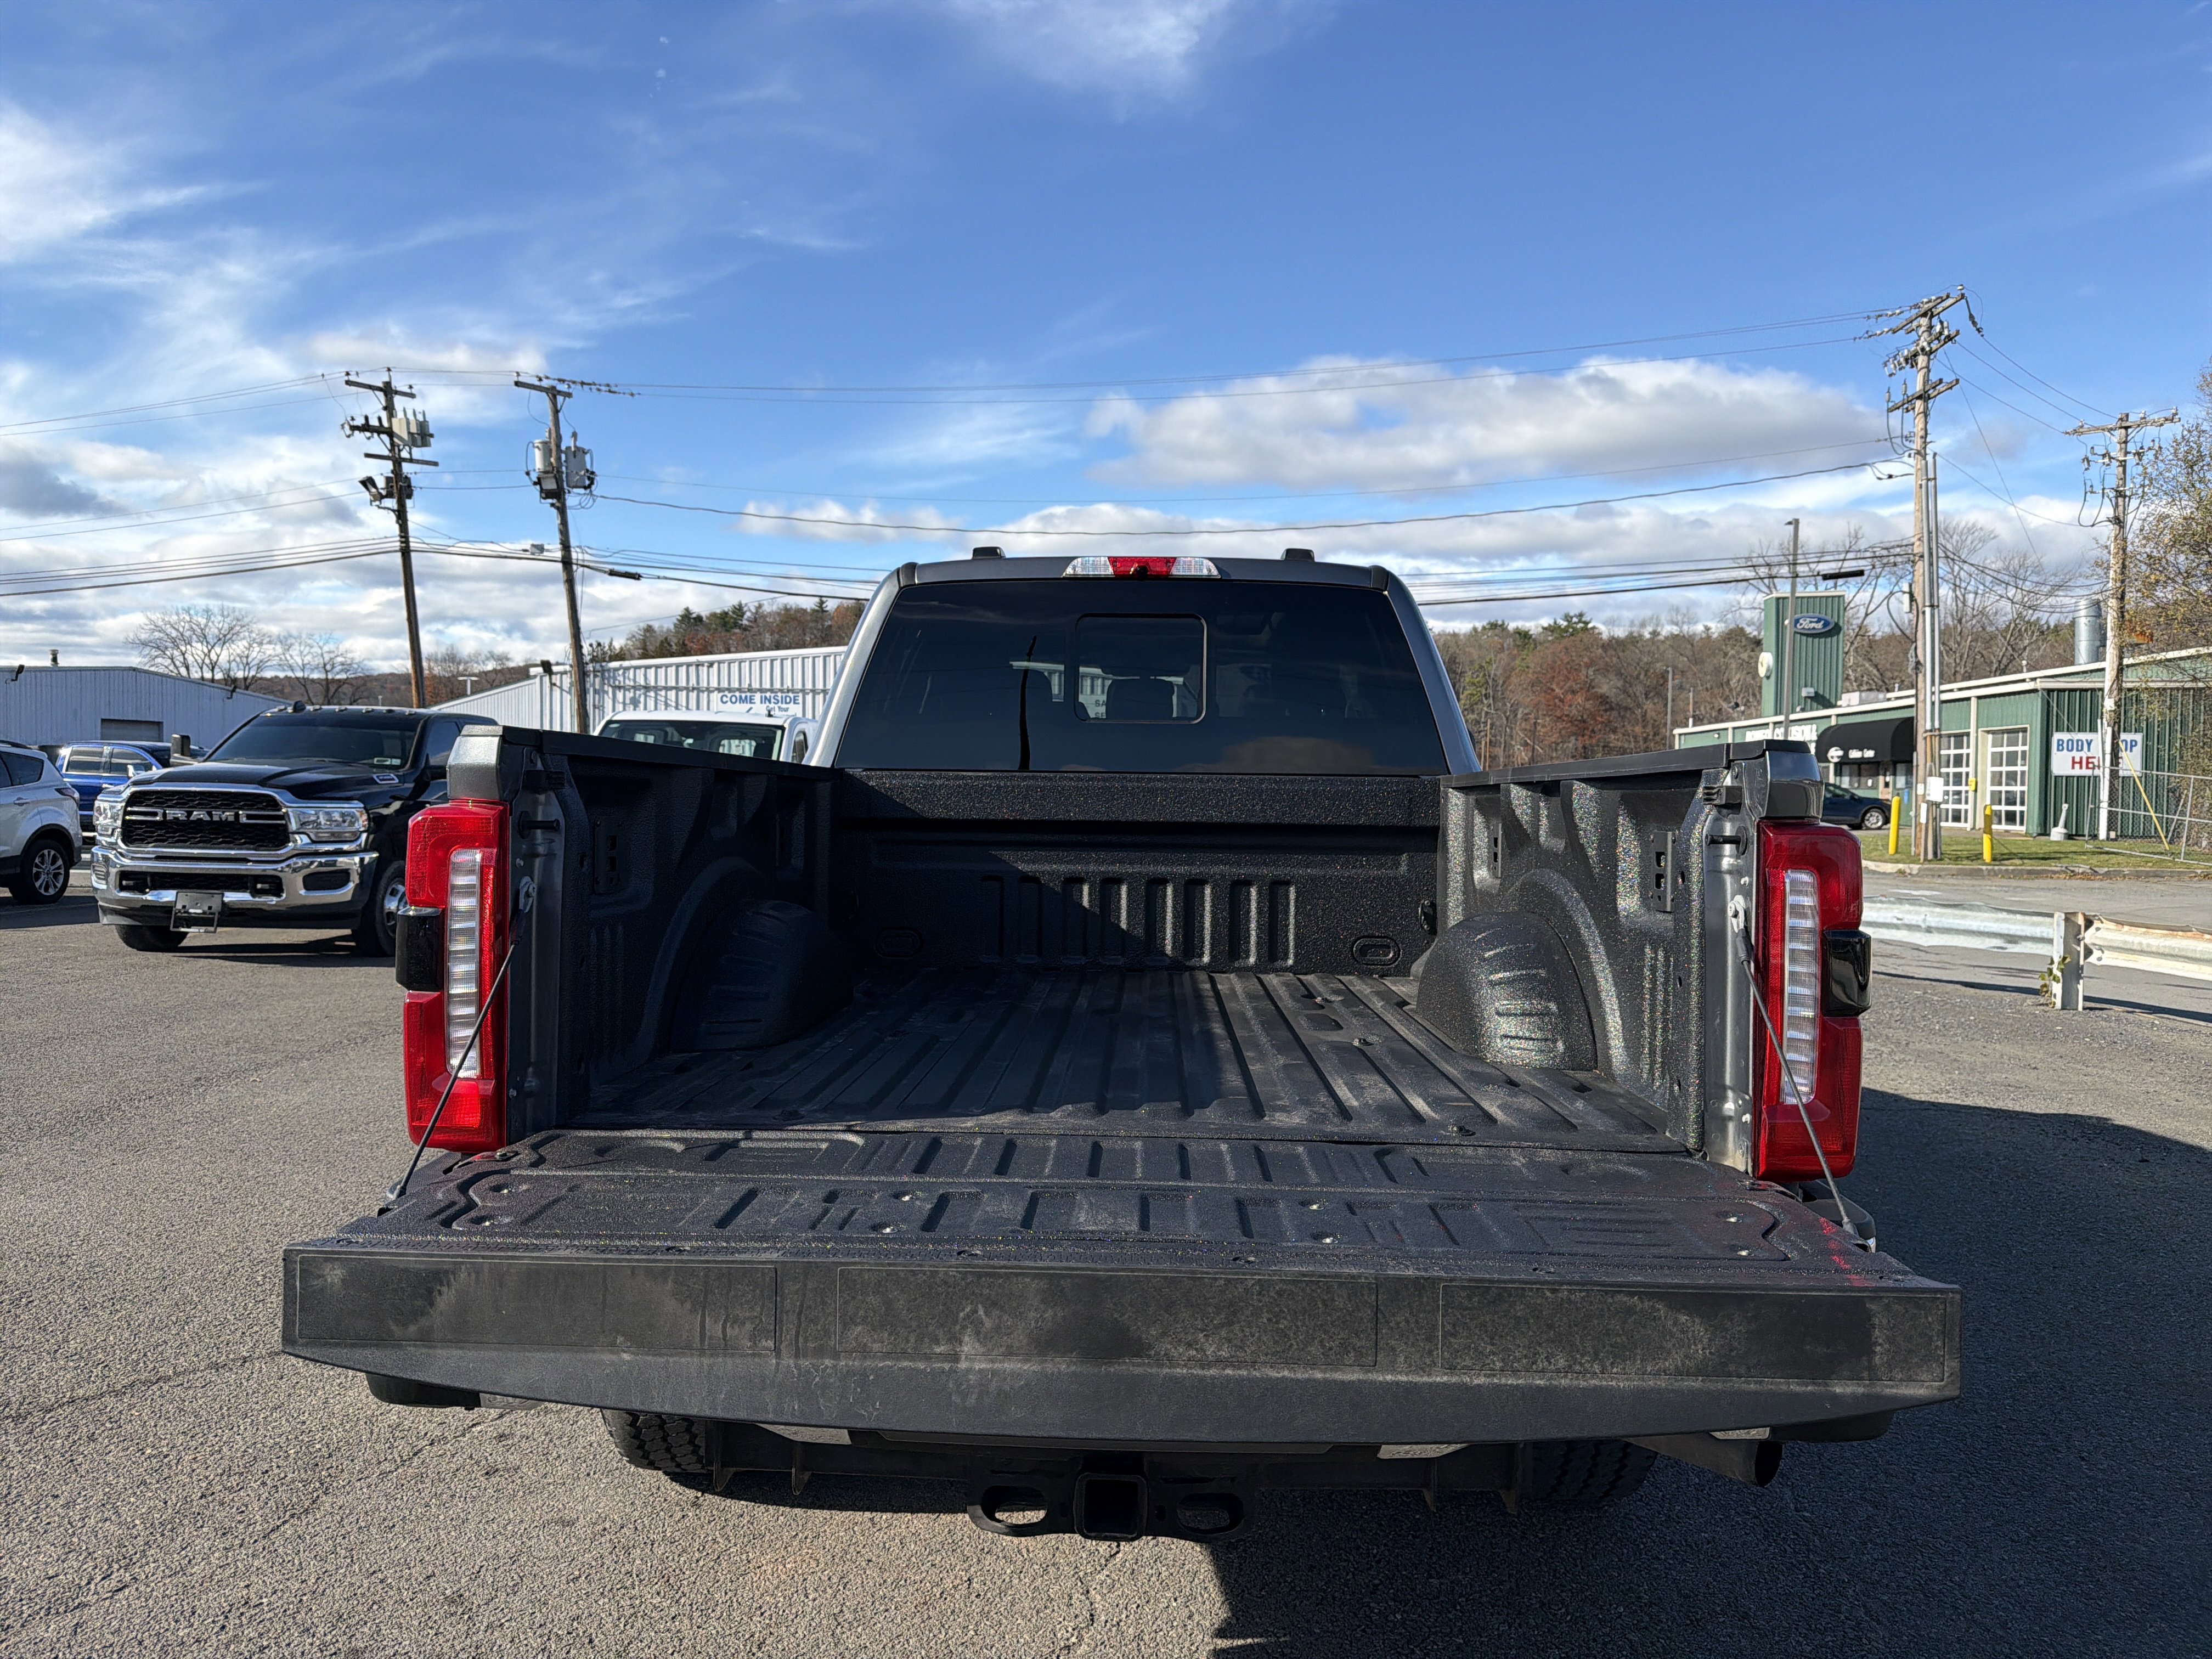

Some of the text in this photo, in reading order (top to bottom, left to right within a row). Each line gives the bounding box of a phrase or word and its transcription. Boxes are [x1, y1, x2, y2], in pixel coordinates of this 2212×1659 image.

[1797, 618, 1824, 629] Ford
[720, 694, 800, 705] COME INSIDE
[2057, 738, 2094, 752] BODY
[166, 810, 235, 821] RAM
